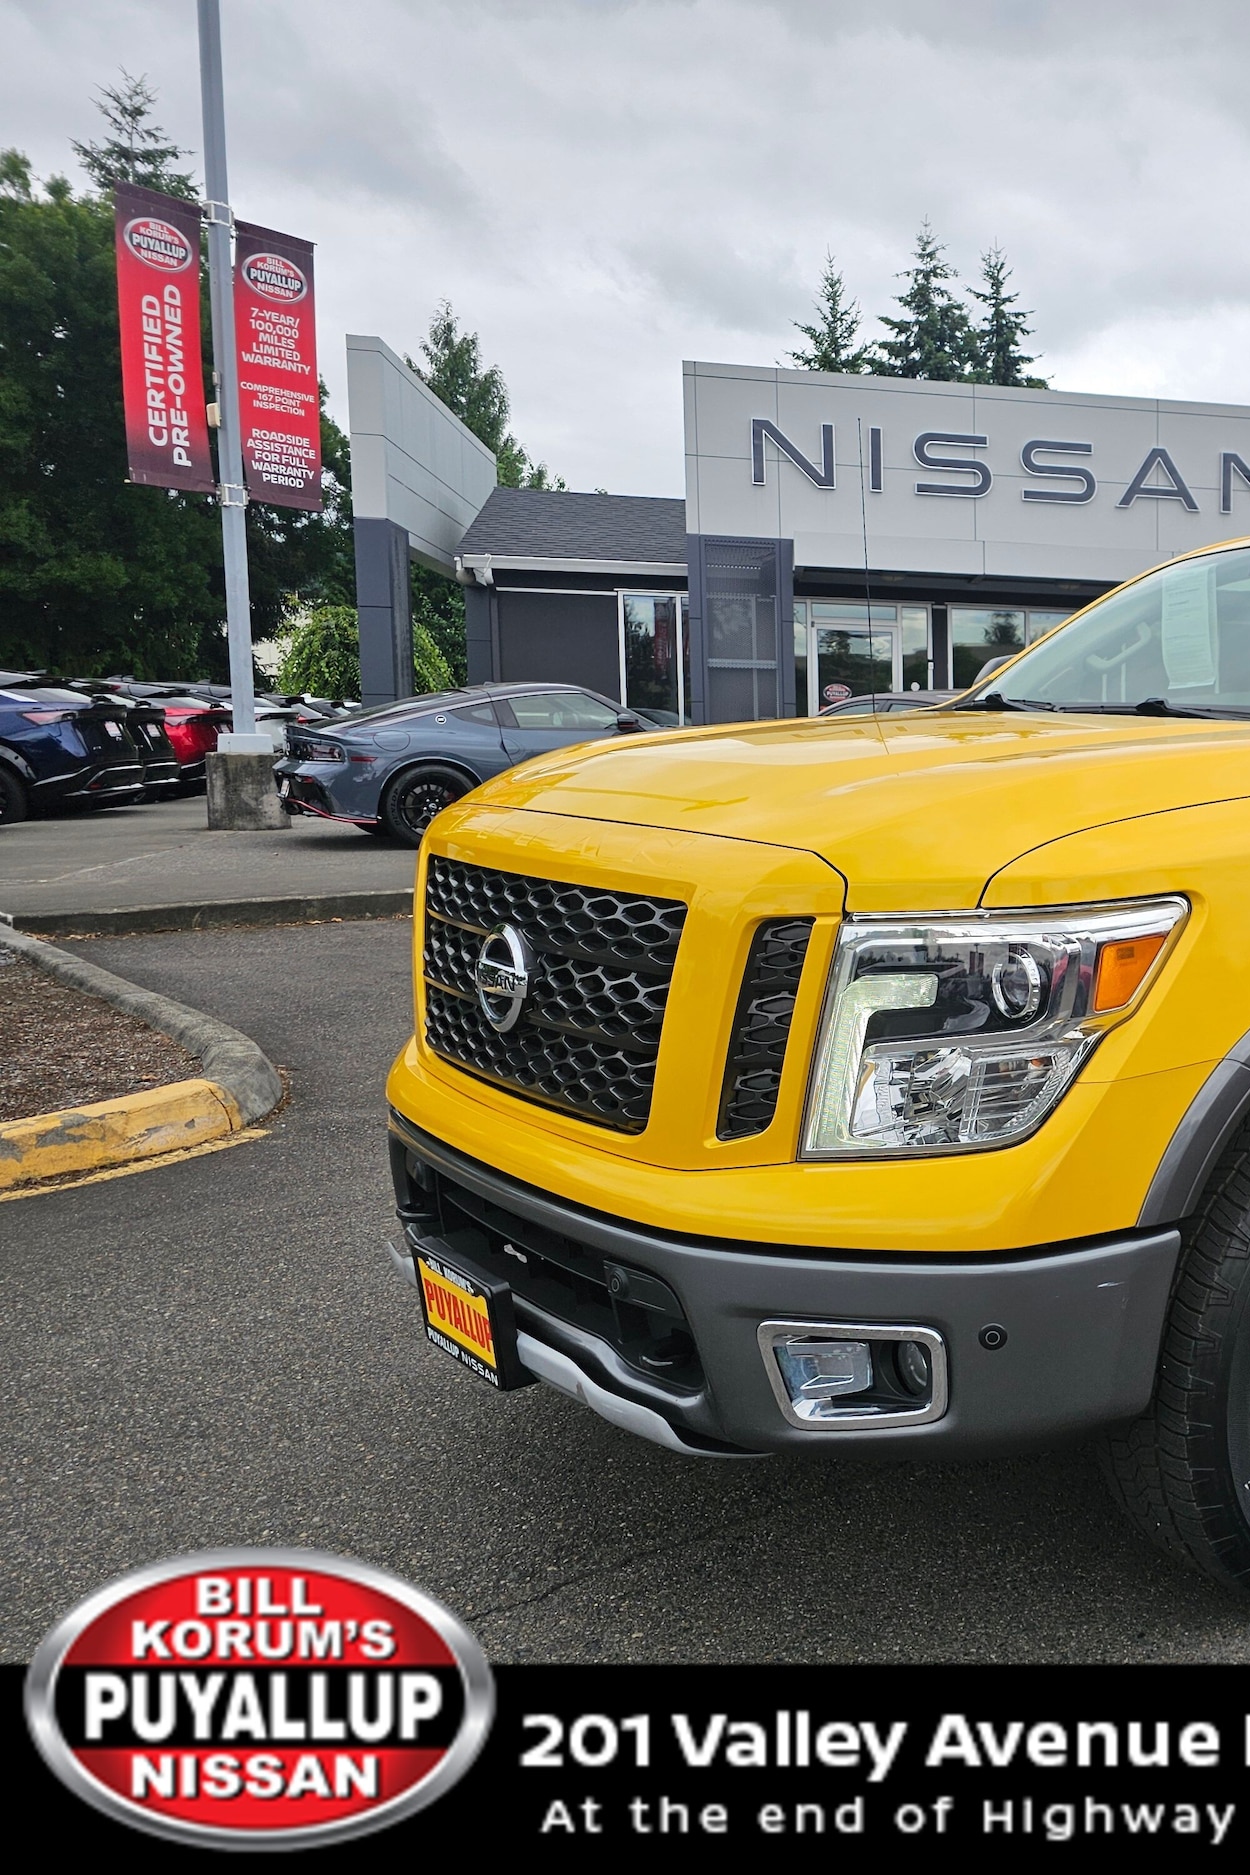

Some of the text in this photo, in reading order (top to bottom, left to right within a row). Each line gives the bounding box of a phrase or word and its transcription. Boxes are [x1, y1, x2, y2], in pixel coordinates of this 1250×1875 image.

[139, 226, 179, 245] KORUM'S
[149, 221, 169, 234] BILL
[132, 232, 186, 259] PUYALLUP
[140, 249, 178, 266] NISSAN
[266, 257, 284, 268] BILL
[250, 267, 301, 291] PUYALLUP
[257, 261, 295, 277] KORUM'S
[257, 282, 293, 298] NISSAN
[250, 307, 300, 329] 7-YEAR/
[249, 319, 299, 339] 100,000
[258, 332, 295, 349] MILES
[252, 342, 301, 362] LIMITED
[142, 294, 168, 447] CERTIFIED
[241, 351, 311, 375] WARRANTY
[163, 284, 192, 467] PRE-OWNED
[240, 381, 315, 403] COMPREHENSIVE
[257, 392, 301, 407] 167 POINT
[252, 400, 305, 416] INSPECTION
[252, 428, 310, 448] ROADSIDE
[247, 438, 316, 459] ASSISTANCE
[255, 450, 308, 468] FOR FULL
[251, 460, 315, 480] WARRANTY
[262, 472, 304, 489] PERIOD
[424, 1278, 492, 1353] PUYALLUP
[427, 1327, 499, 1387] PUYALLUP NISSAN
